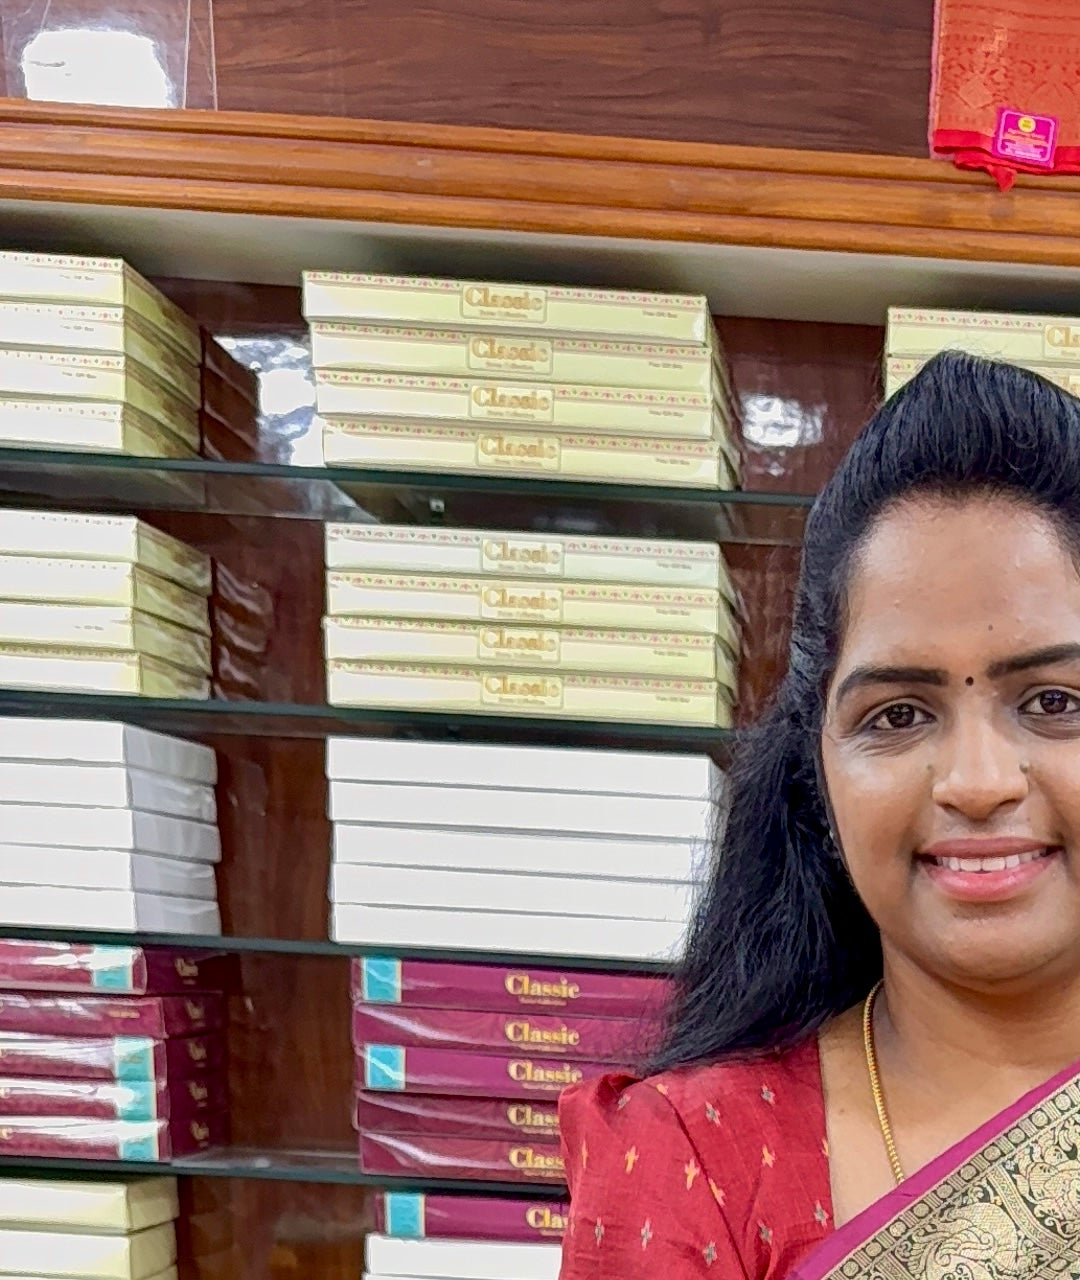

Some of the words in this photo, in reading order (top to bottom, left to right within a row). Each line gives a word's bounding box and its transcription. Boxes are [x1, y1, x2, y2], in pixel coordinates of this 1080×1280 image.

[464, 287, 544, 311] Classic
[471, 338, 548, 362] Classic
[472, 387, 550, 411] Classic
[480, 437, 557, 460] Classic
[484, 541, 560, 564] Classic
[483, 588, 558, 610] Classic
[481, 629, 556, 652] Classic
[484, 676, 559, 698] Classic
[505, 972, 580, 998] Classic
[505, 1022, 580, 1045] Classic
[508, 1060, 582, 1083] Classic
[507, 1104, 560, 1126] Class
[509, 1147, 565, 1169] Class
